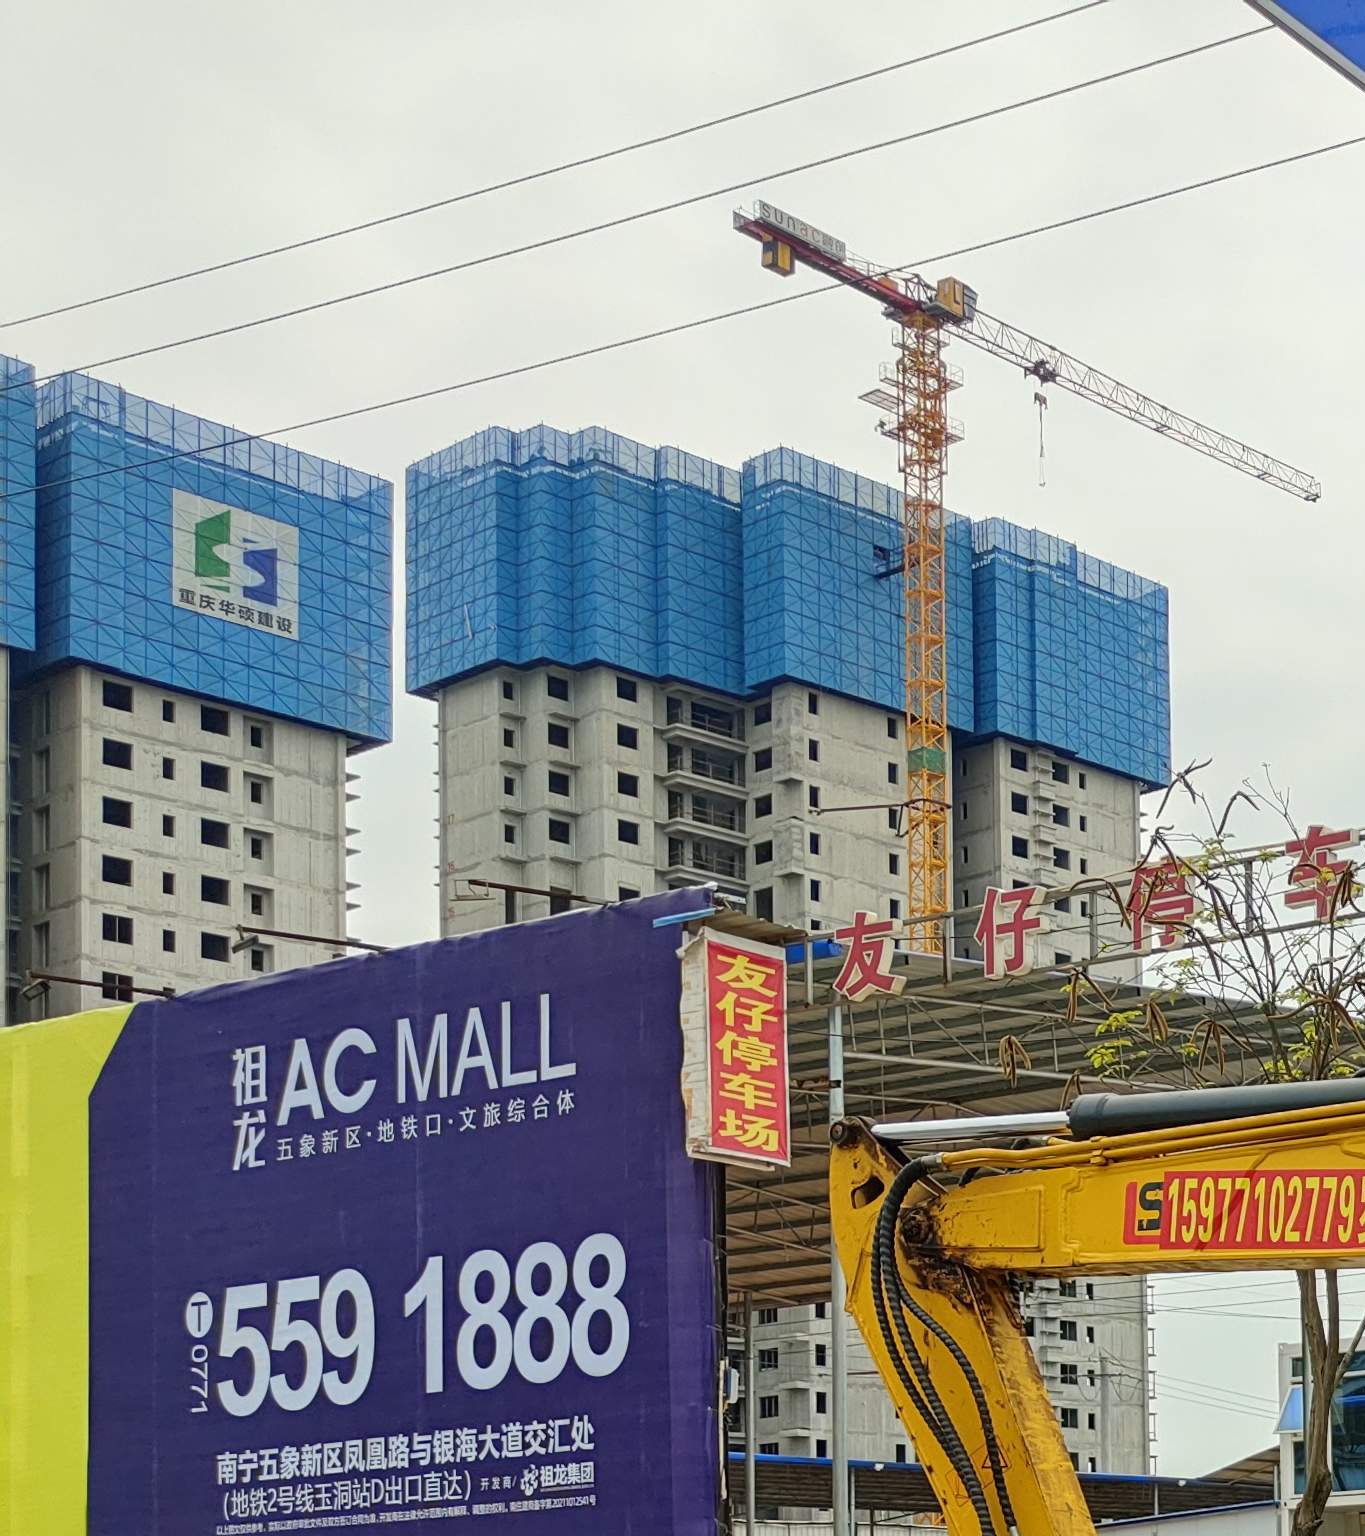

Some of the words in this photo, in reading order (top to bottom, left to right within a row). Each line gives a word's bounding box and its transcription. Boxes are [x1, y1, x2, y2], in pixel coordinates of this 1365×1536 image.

[179, 588, 293, 634] 重庆华硕建设
[276, 1028, 377, 1126] AC
[396, 993, 577, 1103] MALL
[715, 954, 780, 1152] 友仔停车场
[232, 1045, 267, 1170] 祖龙
[216, 1268, 375, 1417] 559
[404, 1232, 630, 1394] 1888
[190, 1344, 209, 1414] 0771
[216, 1414, 595, 1485] 南宁五象新区凤凰路与银海大道交汇处
[540, 1461, 595, 1488] 祖龙集团
